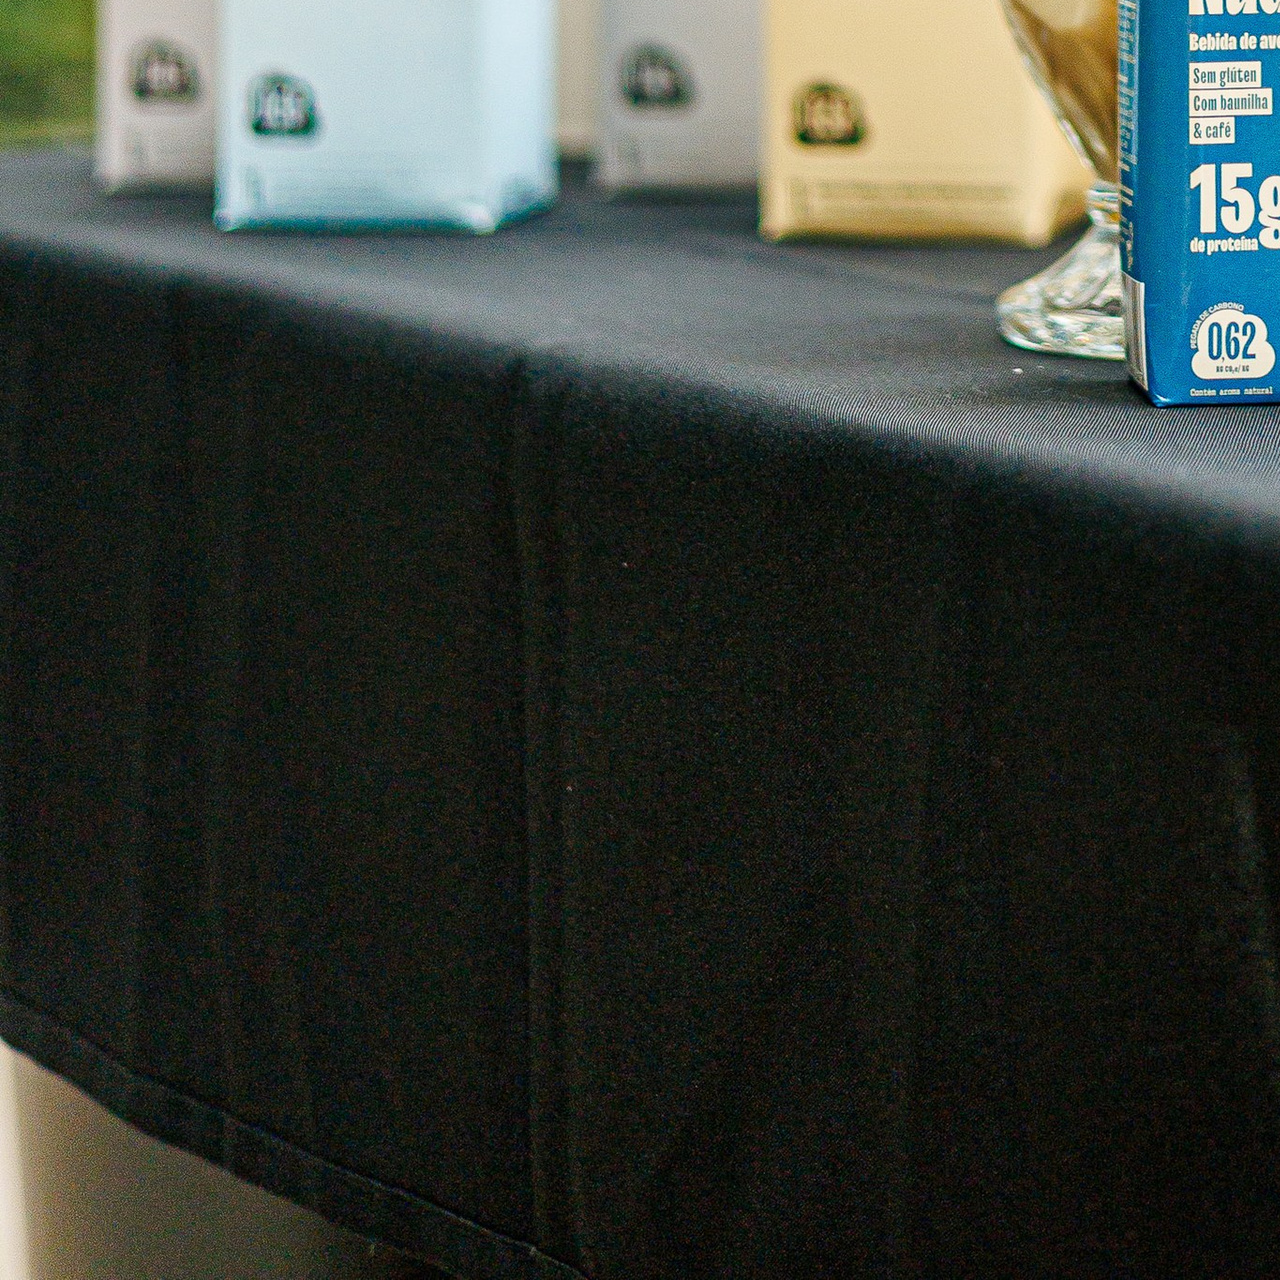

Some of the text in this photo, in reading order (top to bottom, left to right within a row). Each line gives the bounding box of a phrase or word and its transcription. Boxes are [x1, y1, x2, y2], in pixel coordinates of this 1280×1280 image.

[1189, 32, 1237, 51] Bebida
[1239, 32, 1257, 50] de
[1193, 67, 1257, 87] Sem glúten
[1193, 93, 1268, 111] Com baunilha
[1193, 121, 1231, 139] & café
[1190, 235, 1259, 255] de proteína
[1208, 321, 1256, 363] 0,62
